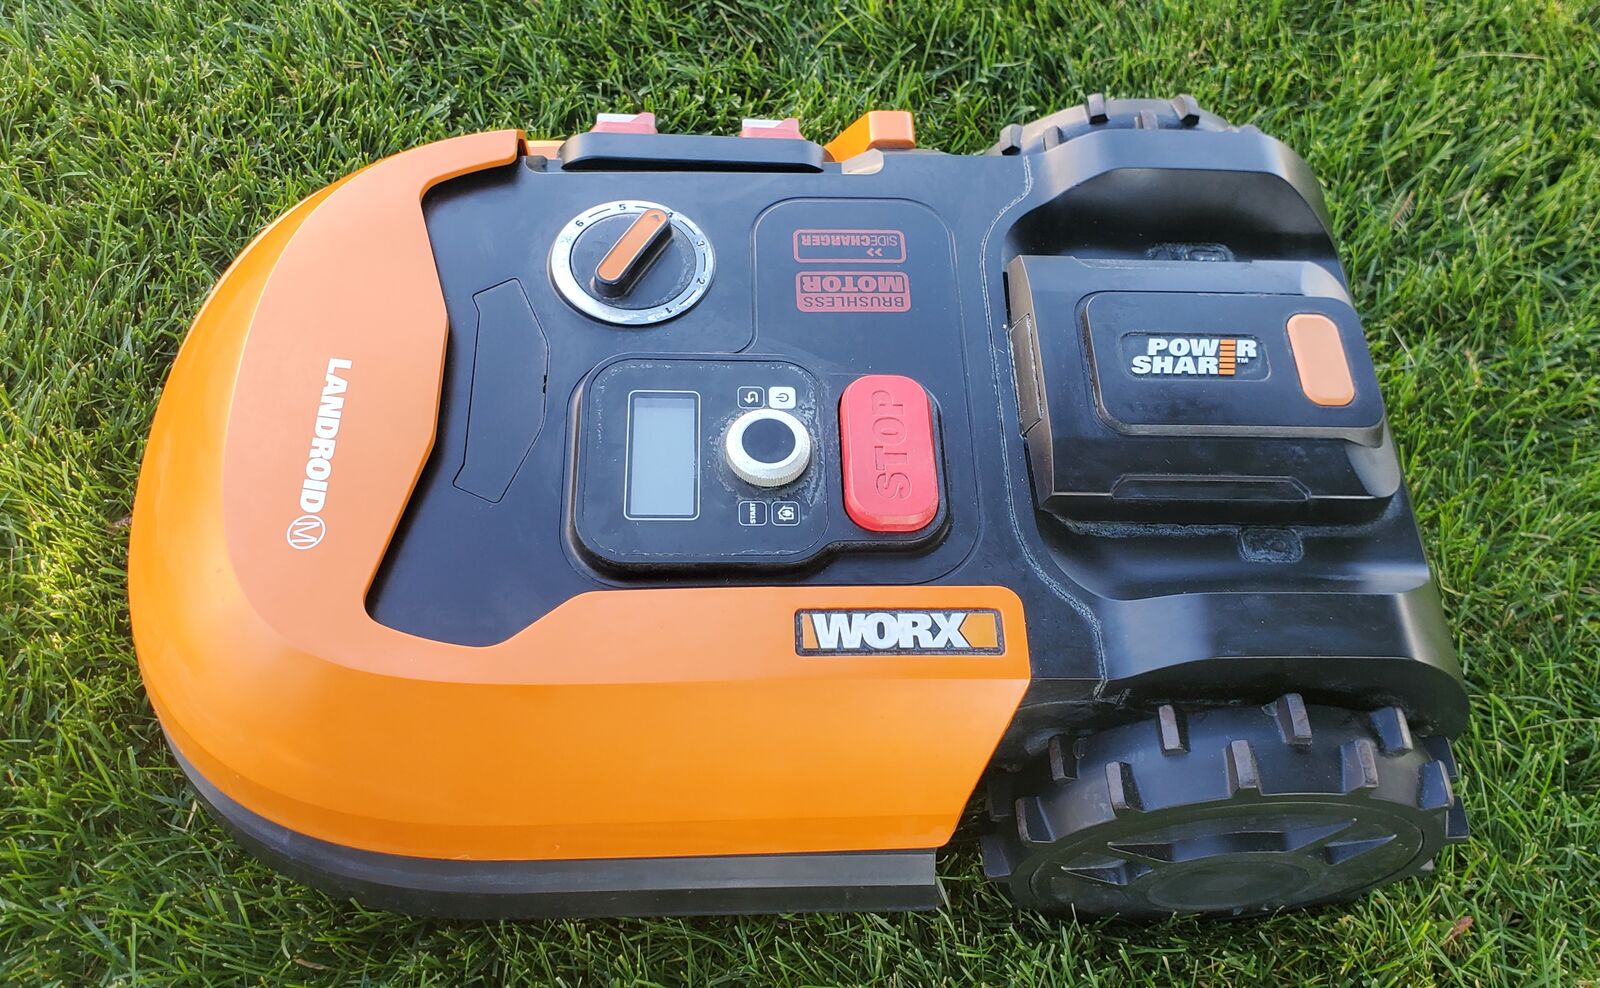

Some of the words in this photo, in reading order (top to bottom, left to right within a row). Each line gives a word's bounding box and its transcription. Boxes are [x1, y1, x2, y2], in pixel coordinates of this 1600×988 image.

[618, 203, 627, 211] 5
[801, 235, 898, 247] SIDECHARGER
[802, 276, 905, 293] MOTOR
[803, 296, 905, 308] BRUSHLESS
[1147, 338, 1257, 358] POWER
[1130, 356, 1236, 376] SHARE
[300, 357, 353, 513] LANDROID
[871, 389, 911, 500] STOP
[749, 502, 757, 525] START
[811, 612, 973, 650] WORX
